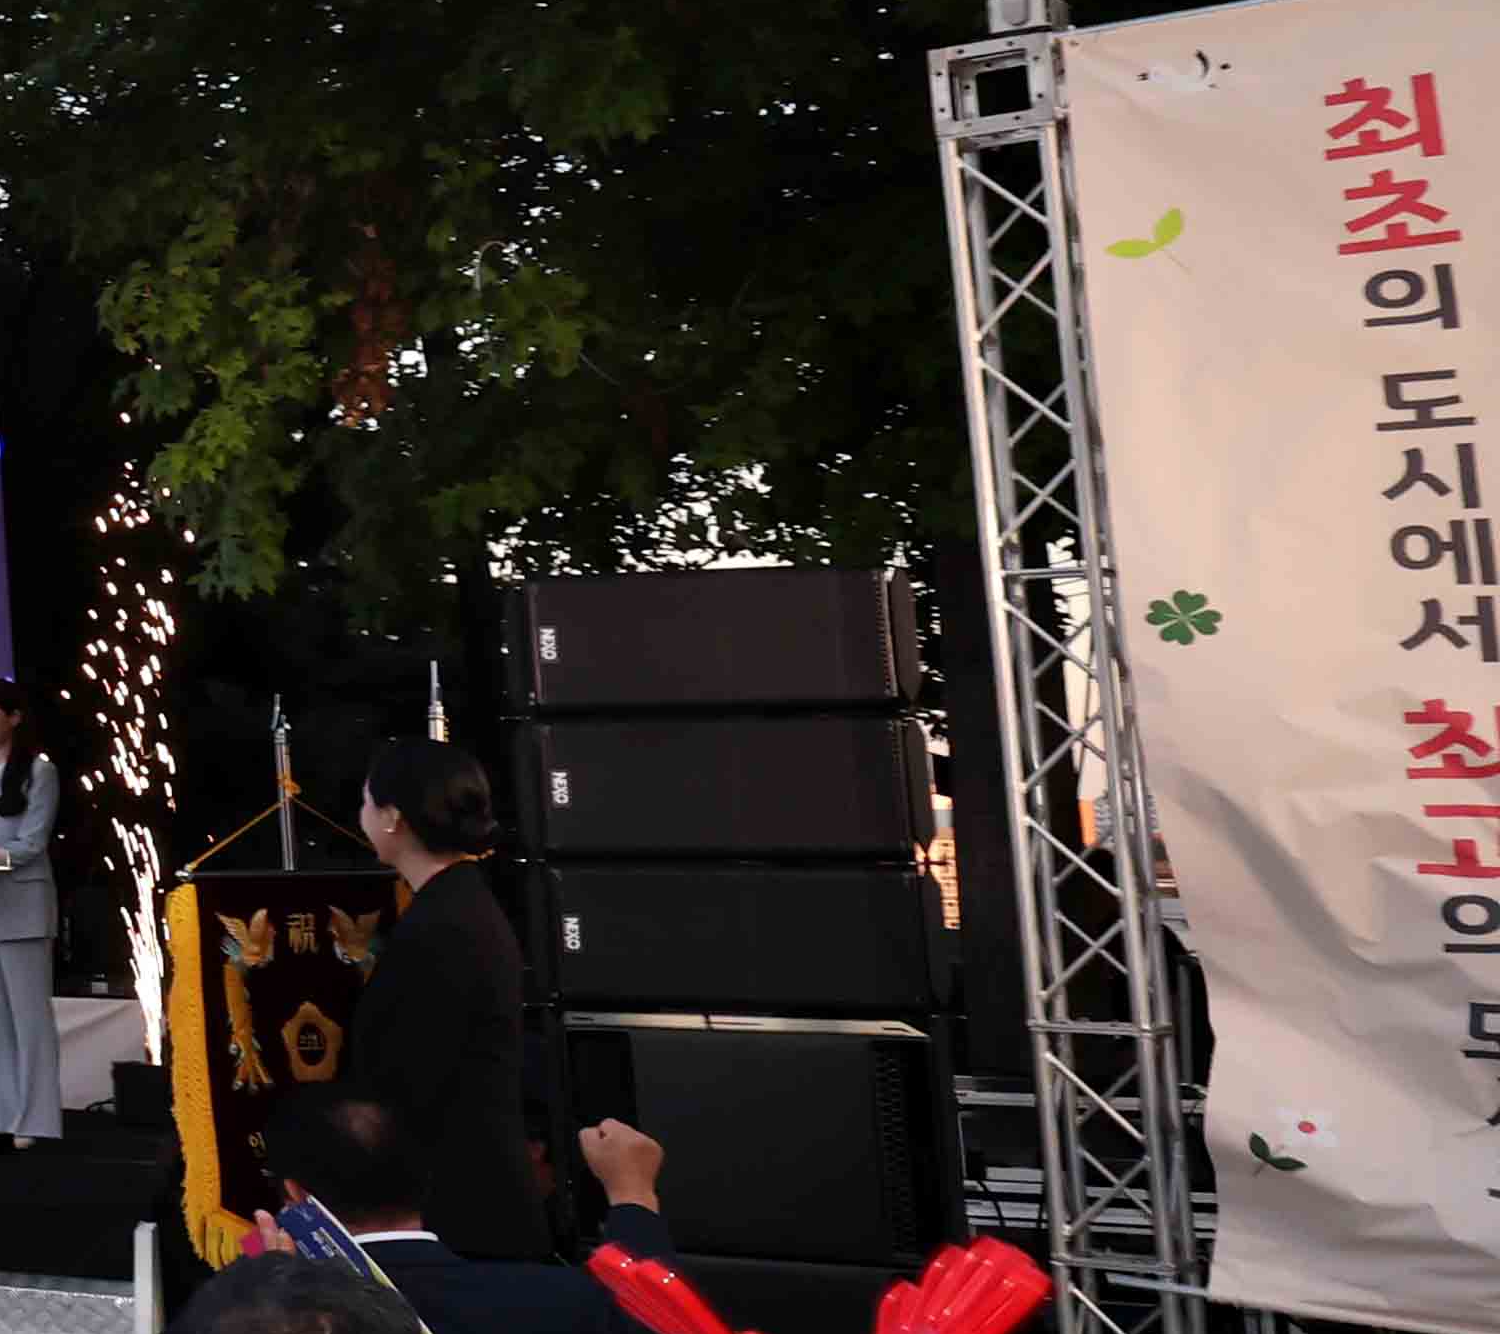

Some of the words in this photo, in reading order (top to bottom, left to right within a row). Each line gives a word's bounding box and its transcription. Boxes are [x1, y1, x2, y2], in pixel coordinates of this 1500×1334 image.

[1324, 72, 1462, 330] 최초의
[1375, 368, 1500, 663] 도시에서
[539, 627, 558, 662] NEXO
[551, 770, 570, 805] NEXO
[562, 916, 581, 951] NEXO
